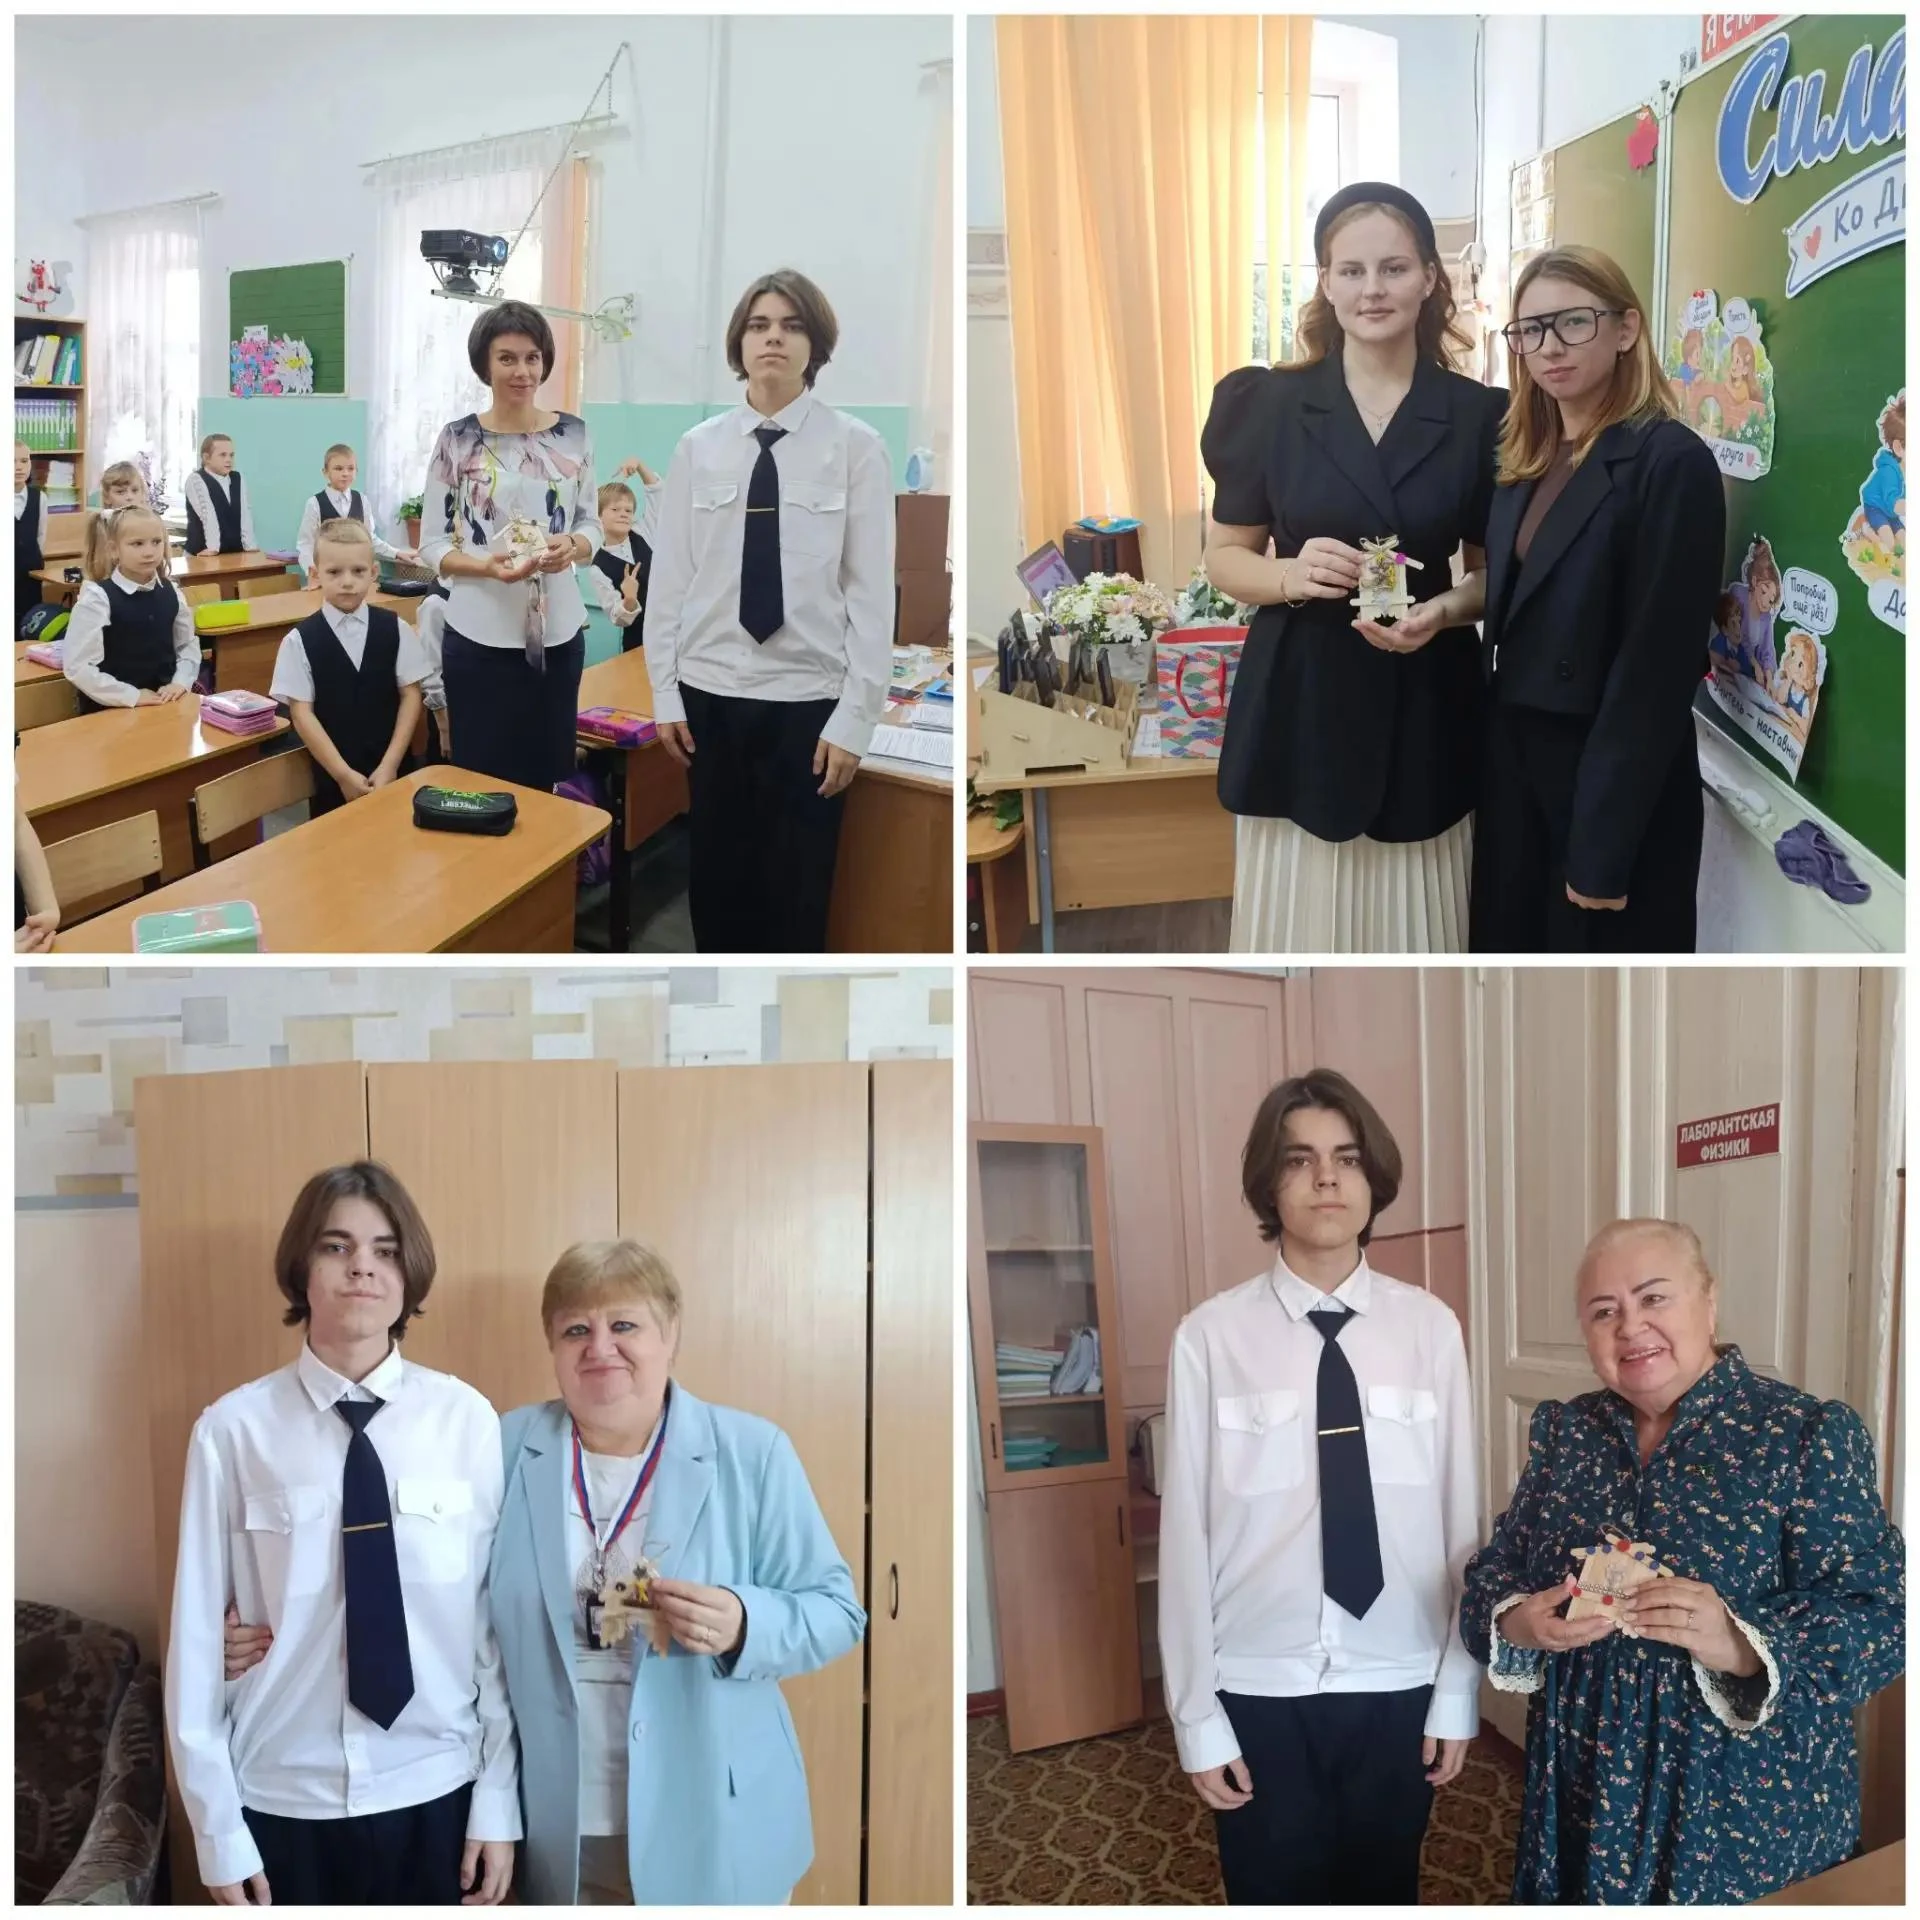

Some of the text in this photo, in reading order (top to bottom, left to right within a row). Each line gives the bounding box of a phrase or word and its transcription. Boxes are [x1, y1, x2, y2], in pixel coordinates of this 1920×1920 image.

[1834, 176, 1906, 243] Ко Д
[1790, 576, 1826, 602] Попробуй
[1810, 607, 1828, 623] раз!
[1680, 1108, 1776, 1143] ЛАБОРАНТСКАЯ
[1700, 1137, 1750, 1161] ФИЗИКИ
